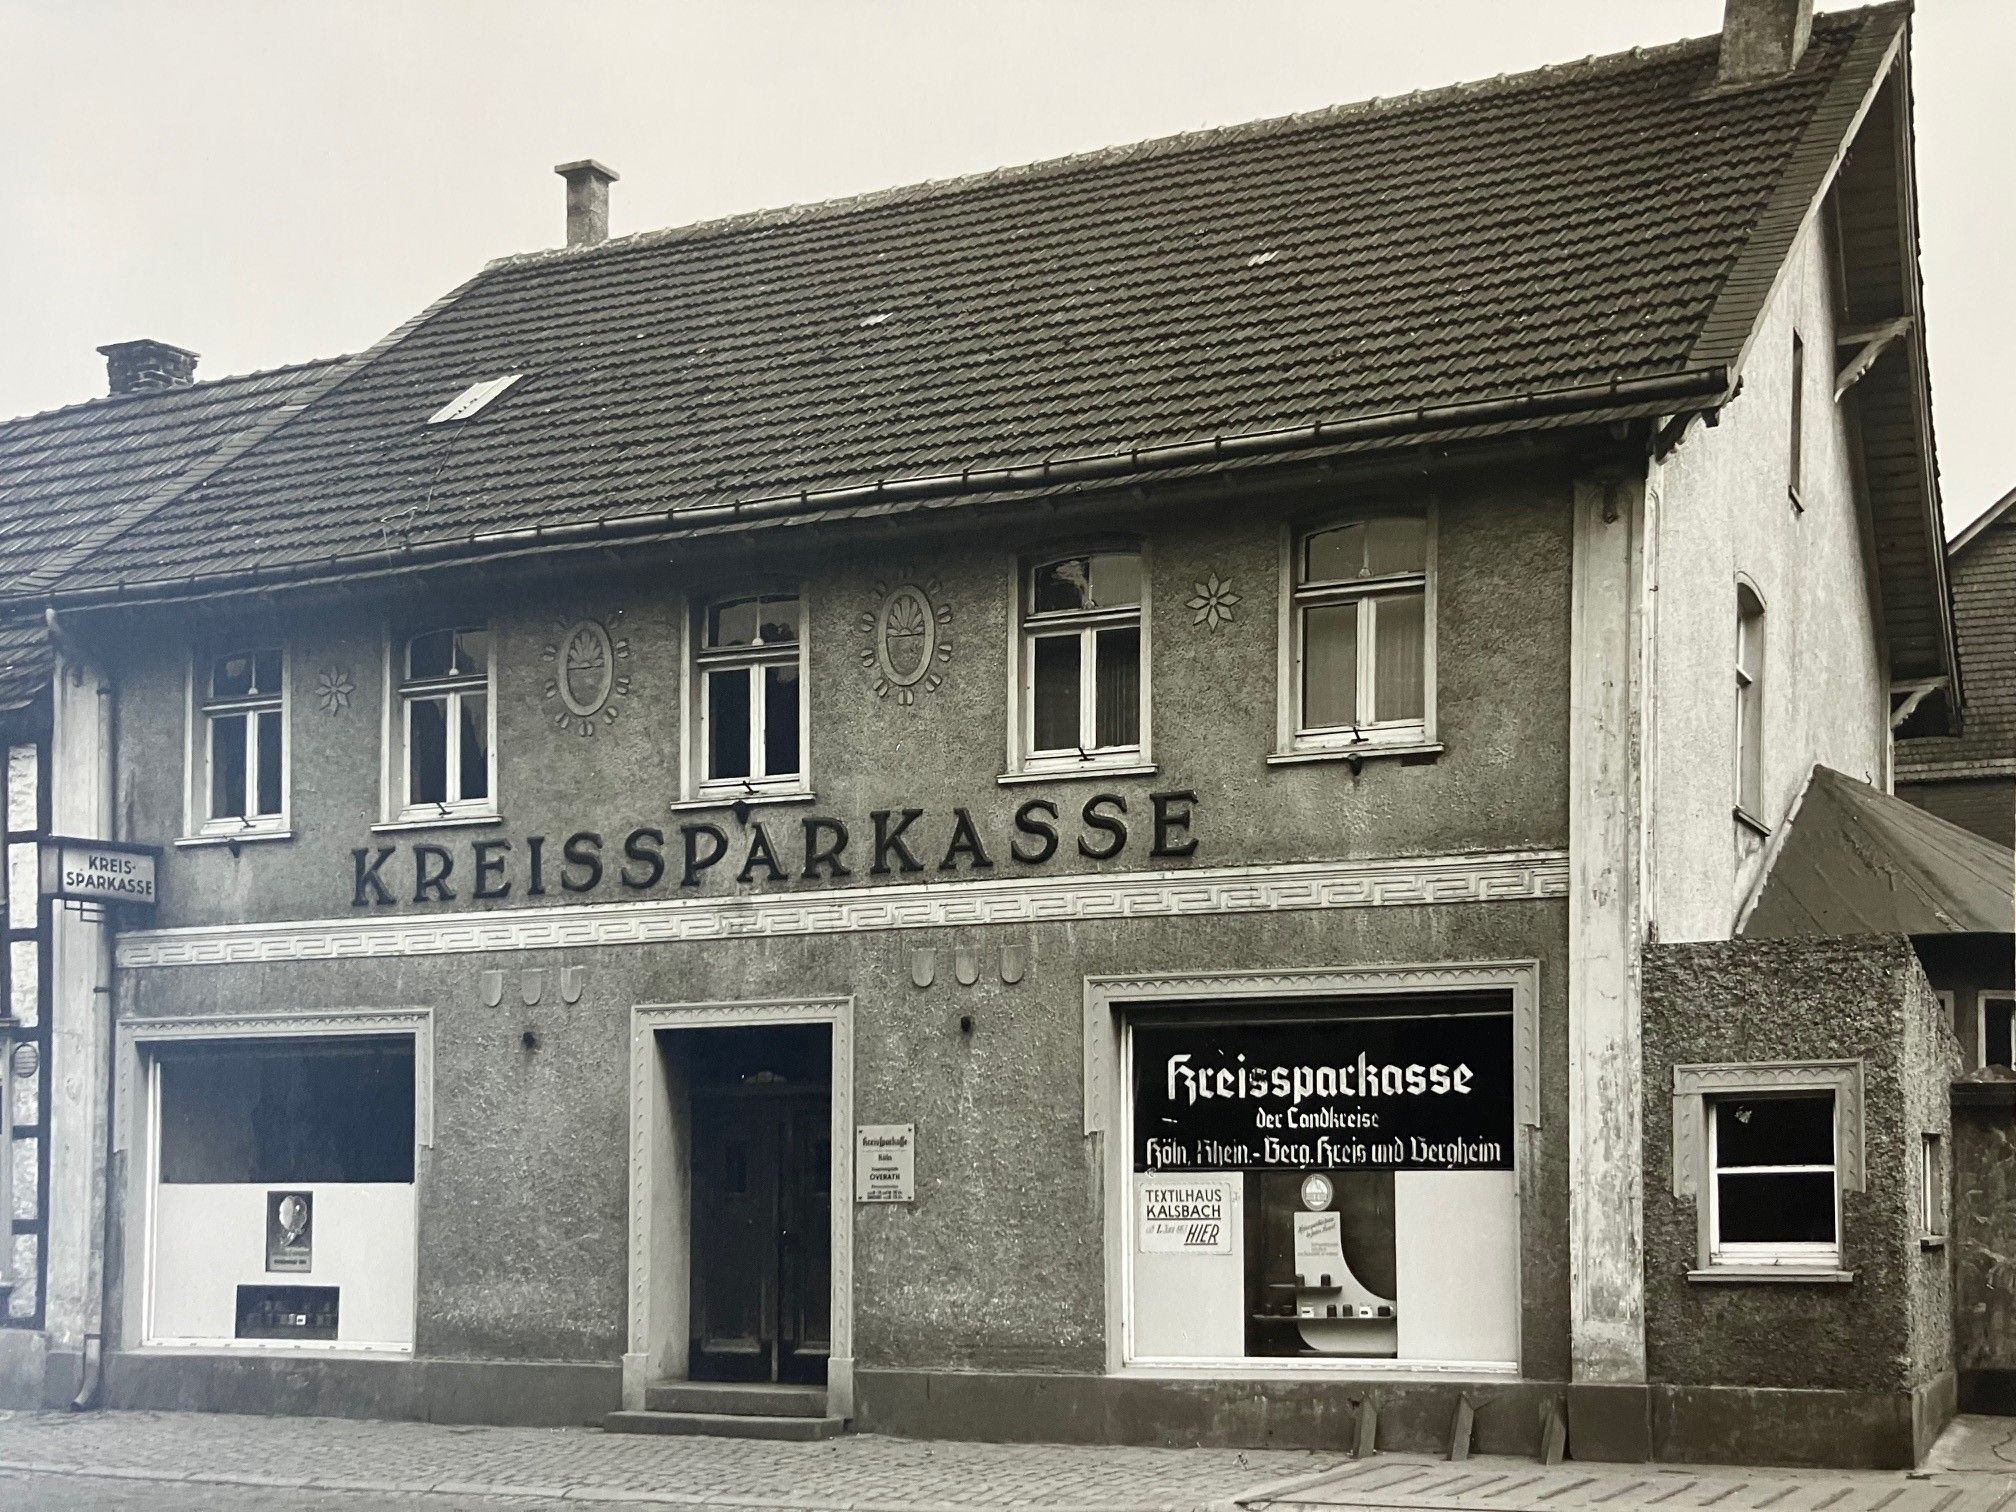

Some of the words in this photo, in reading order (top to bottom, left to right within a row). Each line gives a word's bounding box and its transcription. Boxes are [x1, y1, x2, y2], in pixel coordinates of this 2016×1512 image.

[351, 789, 1200, 907] KREISSPARKASSE
[89, 855, 136, 874] KREIS-
[66, 871, 152, 895] SPARKASSE
[1167, 1051, 1474, 1106] Kreissparkasse
[1256, 1106, 1283, 1129] der
[1287, 1106, 1380, 1129] Landkreise
[1146, 1138, 1191, 1169] Köln,
[1317, 1136, 1367, 1168] Kreis
[1371, 1136, 1404, 1163] und
[1410, 1135, 1501, 1169] Bergheim
[1145, 1189, 1222, 1203] TEXTILHAUS
[1146, 1204, 1221, 1218] KALSBACH
[1185, 1224, 1220, 1243] HIER
